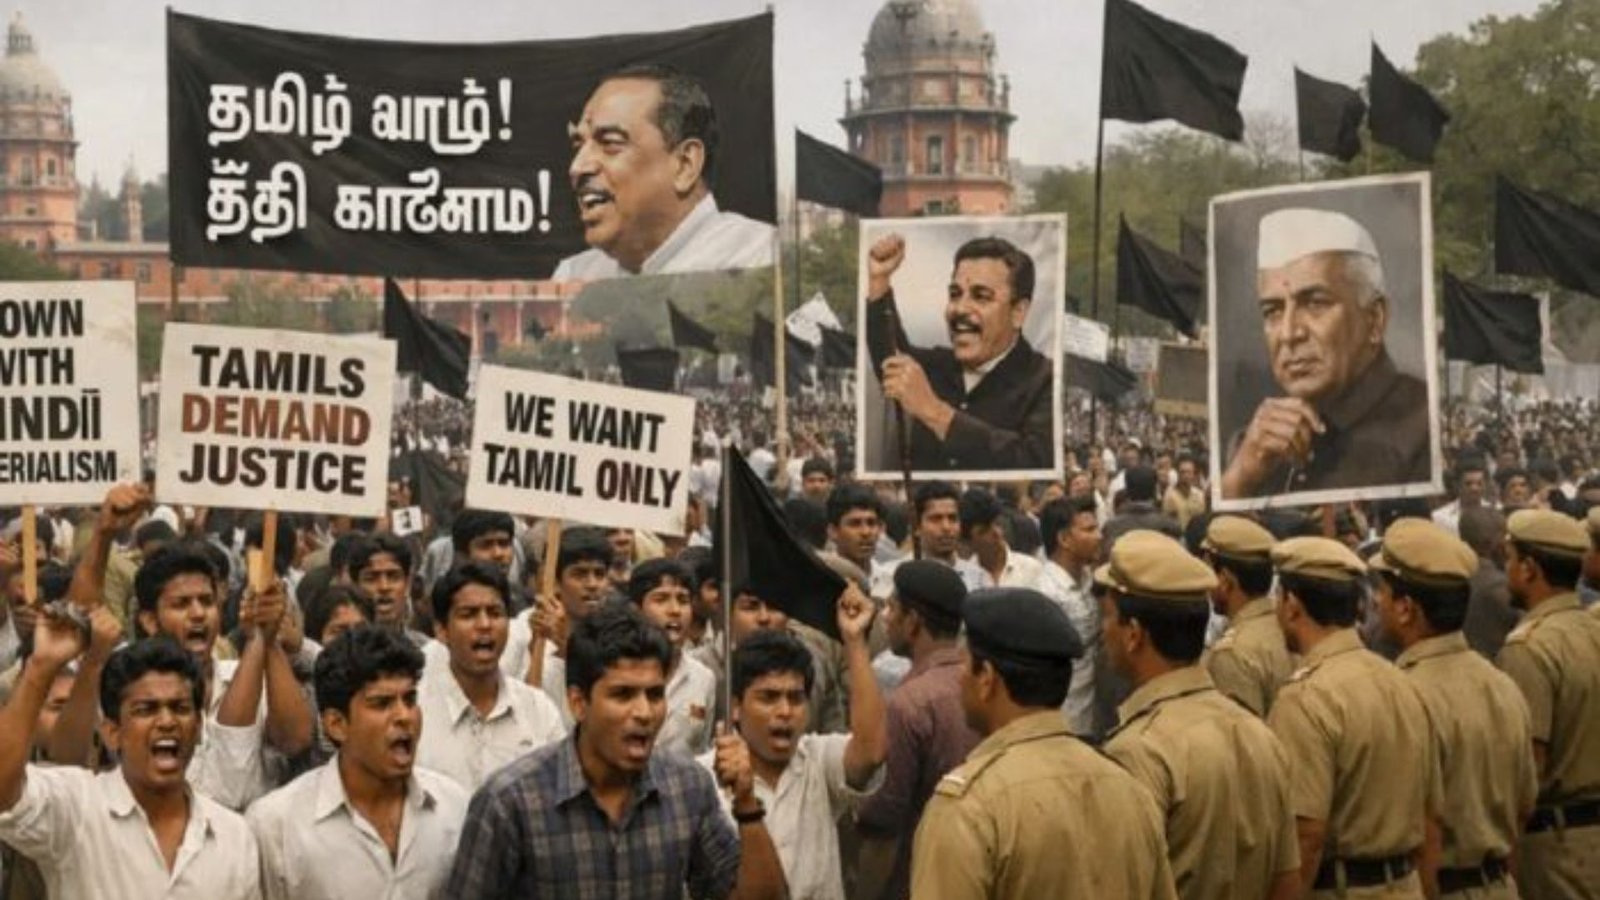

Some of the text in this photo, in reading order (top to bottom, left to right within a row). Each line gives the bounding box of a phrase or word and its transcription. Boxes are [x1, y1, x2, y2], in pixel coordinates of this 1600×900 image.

[208, 71, 351, 156] தமிழ்
[192, 344, 365, 398] TAMILS
[181, 393, 371, 446] DEMAND
[505, 391, 665, 453] WE WANT
[179, 442, 367, 496] JUSTICE
[483, 443, 681, 508] TAMIL ONLY
